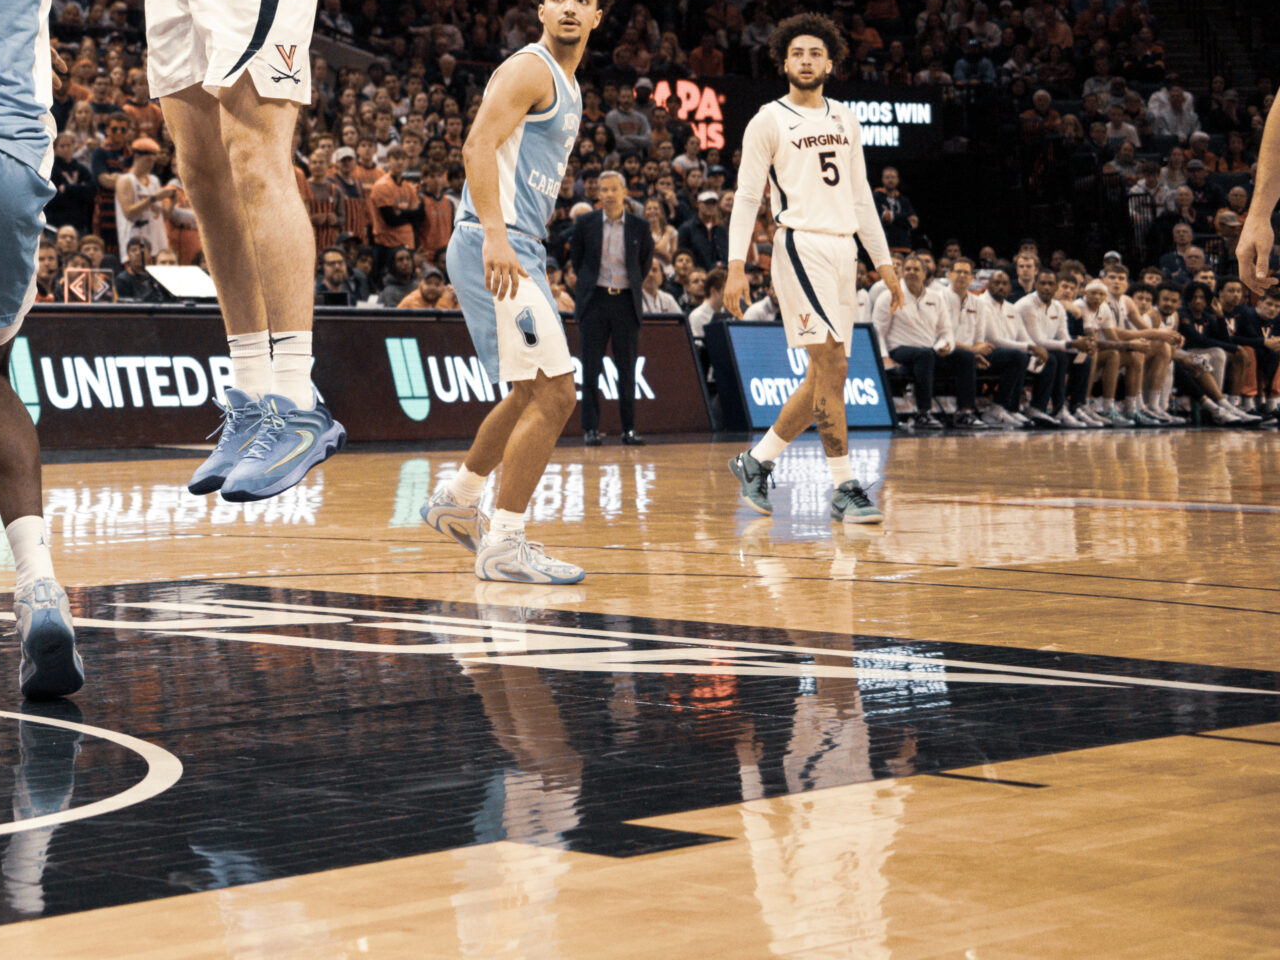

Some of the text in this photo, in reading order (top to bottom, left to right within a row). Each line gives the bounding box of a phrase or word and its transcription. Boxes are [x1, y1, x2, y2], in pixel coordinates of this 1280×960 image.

[632, 79, 723, 121] APA
[894, 102, 932, 125] WIN
[791, 134, 850, 150] VIRGINIA
[861, 125, 900, 147] WIN!
[818, 151, 841, 187] 5
[40, 355, 209, 410] UNITED
